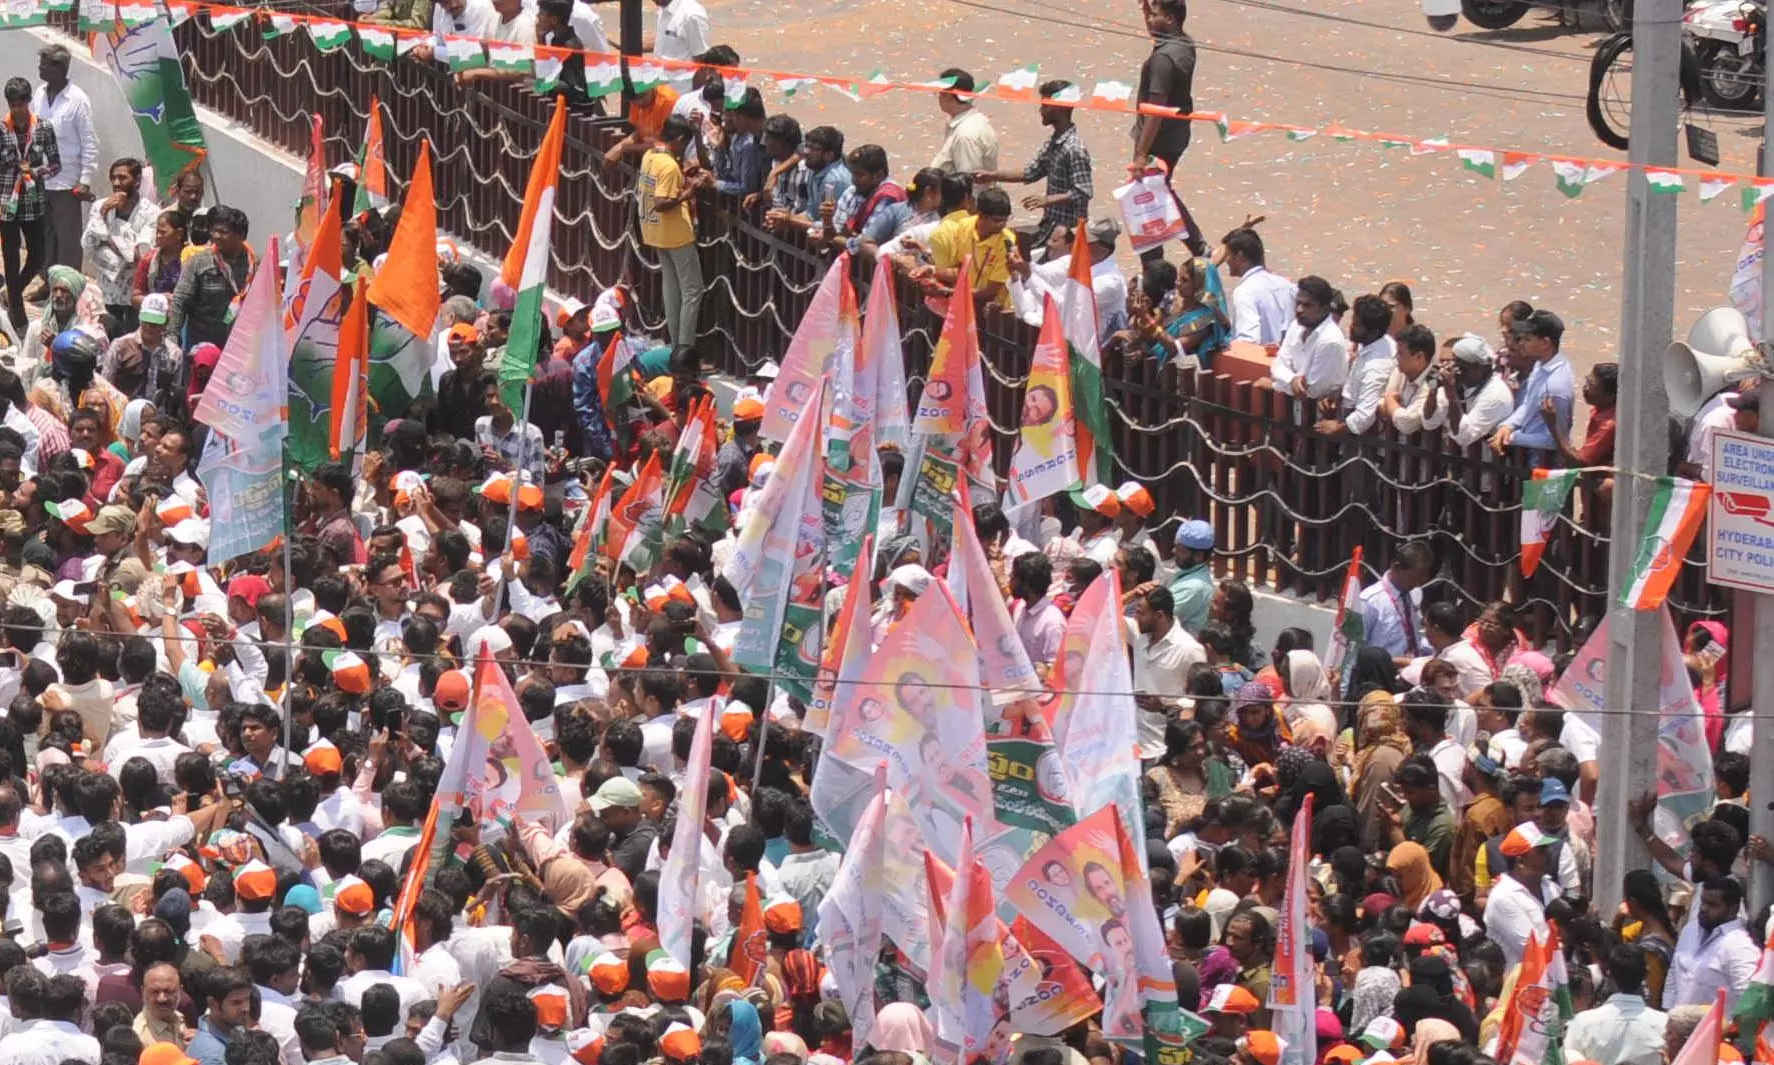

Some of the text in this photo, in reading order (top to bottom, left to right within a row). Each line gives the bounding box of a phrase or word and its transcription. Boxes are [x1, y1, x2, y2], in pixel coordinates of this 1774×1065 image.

[1723, 443, 1748, 458] AREA
[1717, 528, 1774, 549] HYDERAB
[1716, 547, 1744, 562] CITY
